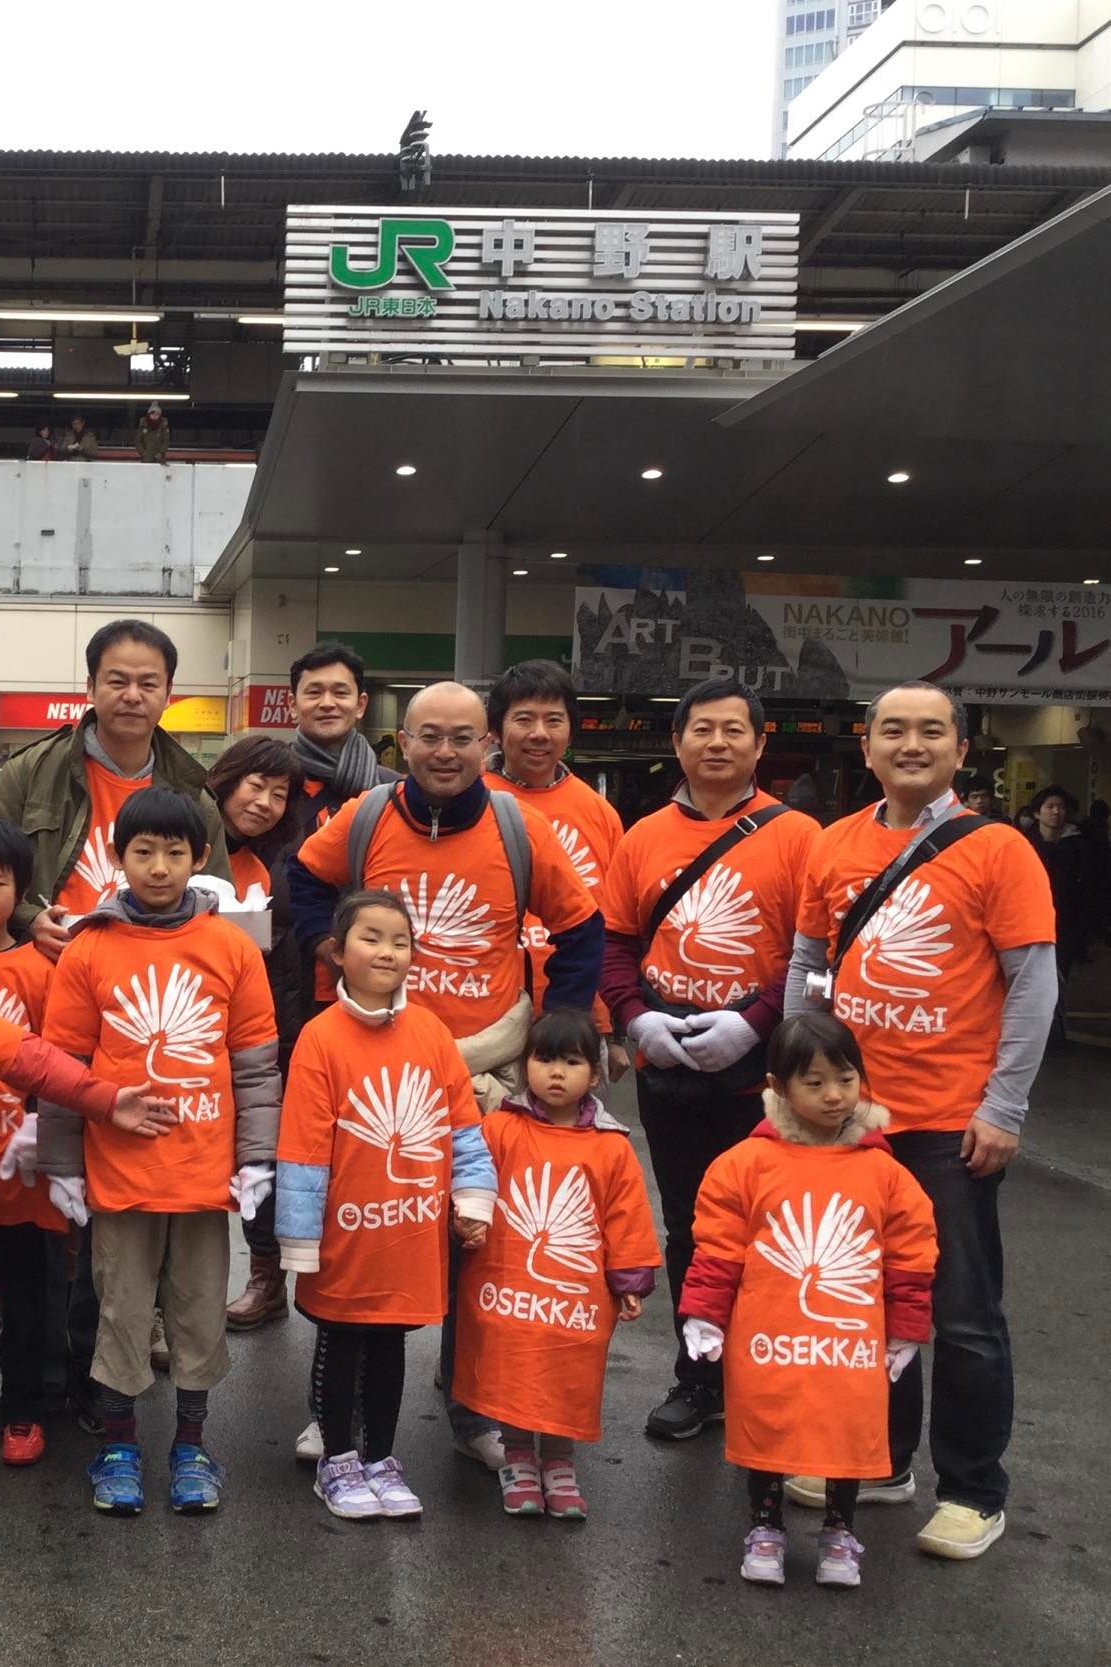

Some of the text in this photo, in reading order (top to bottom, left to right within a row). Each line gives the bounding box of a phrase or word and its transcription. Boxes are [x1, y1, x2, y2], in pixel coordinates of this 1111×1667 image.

[329, 217, 456, 290] JR
[481, 219, 762, 281] 中野駅
[348, 296, 437, 317] JR東日本
[479, 288, 762, 323] Nakano Station
[593, 602, 682, 657] ART
[783, 602, 910, 628] NAKANO
[260, 706, 294, 724] DAY
[263, 689, 291, 706] NE
[834, 992, 947, 1033] SEKKAI
[479, 1282, 598, 1331] OSEKKAI
[750, 1333, 878, 1369] OSEKKAI
